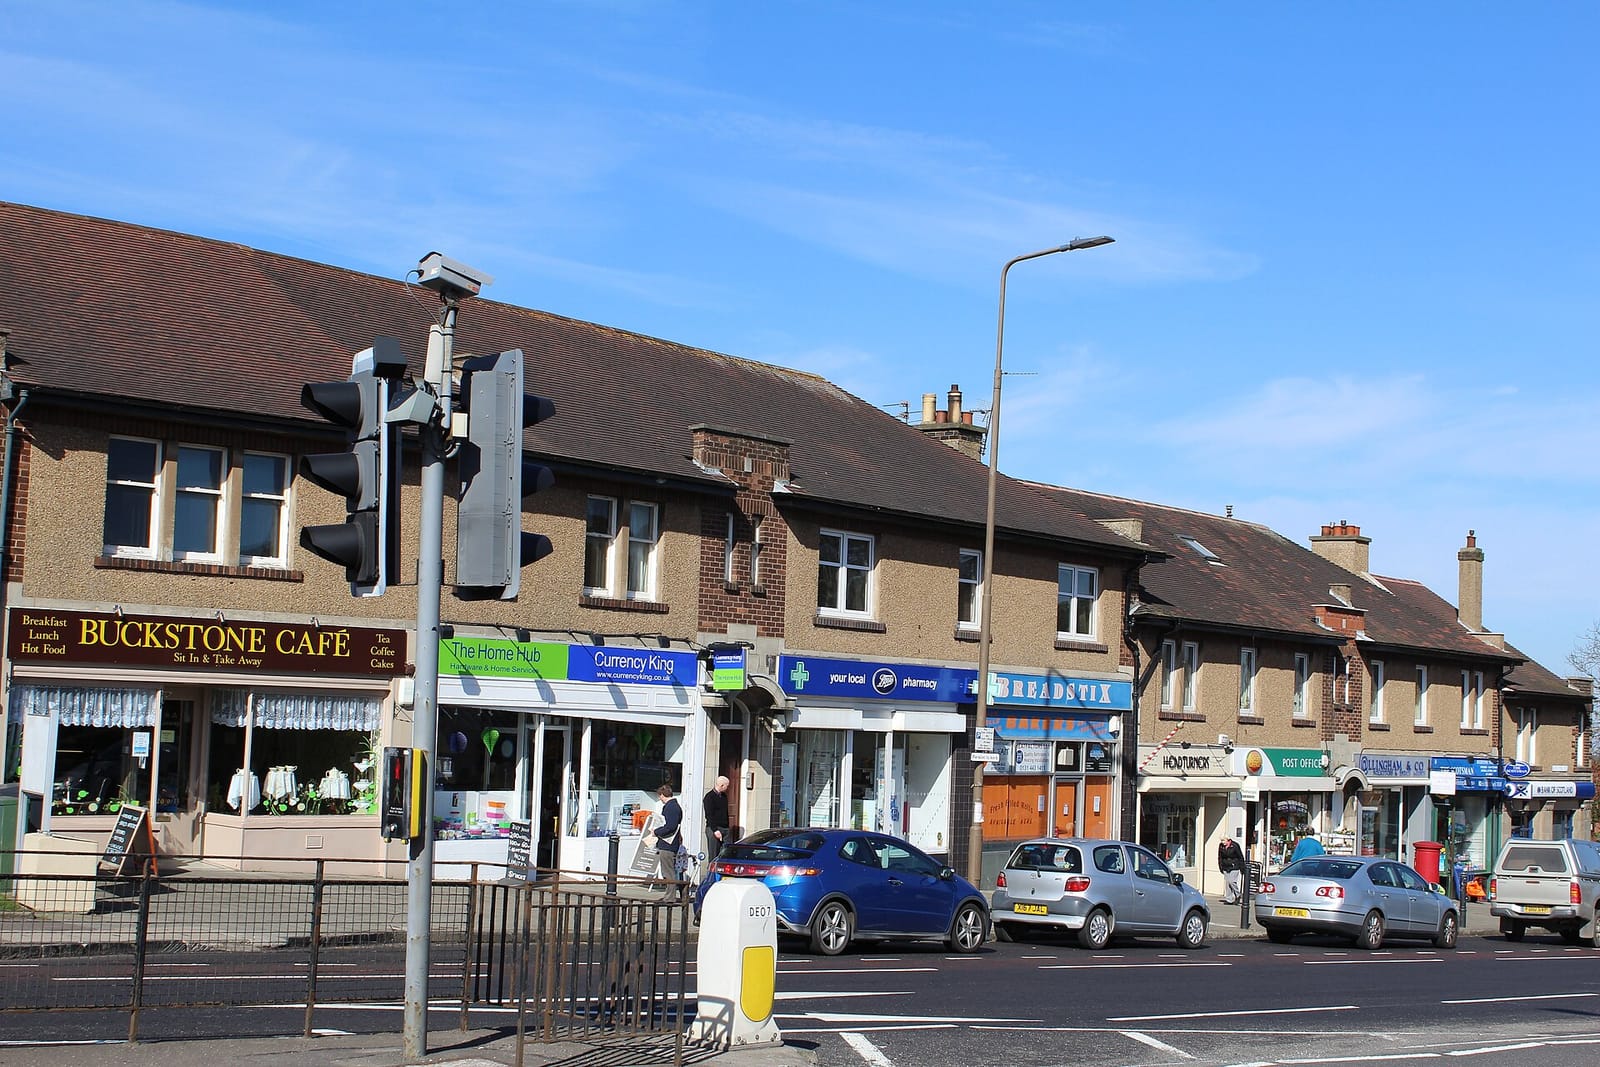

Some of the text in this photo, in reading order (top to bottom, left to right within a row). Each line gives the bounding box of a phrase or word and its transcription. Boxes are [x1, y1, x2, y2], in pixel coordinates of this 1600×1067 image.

[22, 615, 67, 627] Breakfast
[29, 629, 59, 640] Lunch
[78, 618, 350, 657] BUCKSTONE CAFÉ
[376, 634, 391, 644] Tea
[21, 643, 66, 654] Hot Food
[370, 646, 395, 656] Coffee
[452, 641, 541, 663] The Home Hub
[173, 652, 262, 668] Sit In & Take Away
[370, 659, 394, 669] Cakes
[594, 651, 674, 674] Currency King
[450, 663, 482, 671] Hardware
[490, 665, 510, 673] Home
[596, 672, 670, 682] www.currencyking.co.uk
[829, 673, 846, 684] your
[848, 673, 866, 684] local
[903, 677, 938, 690] pharmacy
[996, 677, 1111, 704] BREADSTIX
[1282, 758, 1322, 768] POST OFFICE
[1406, 761, 1411, 771] &
